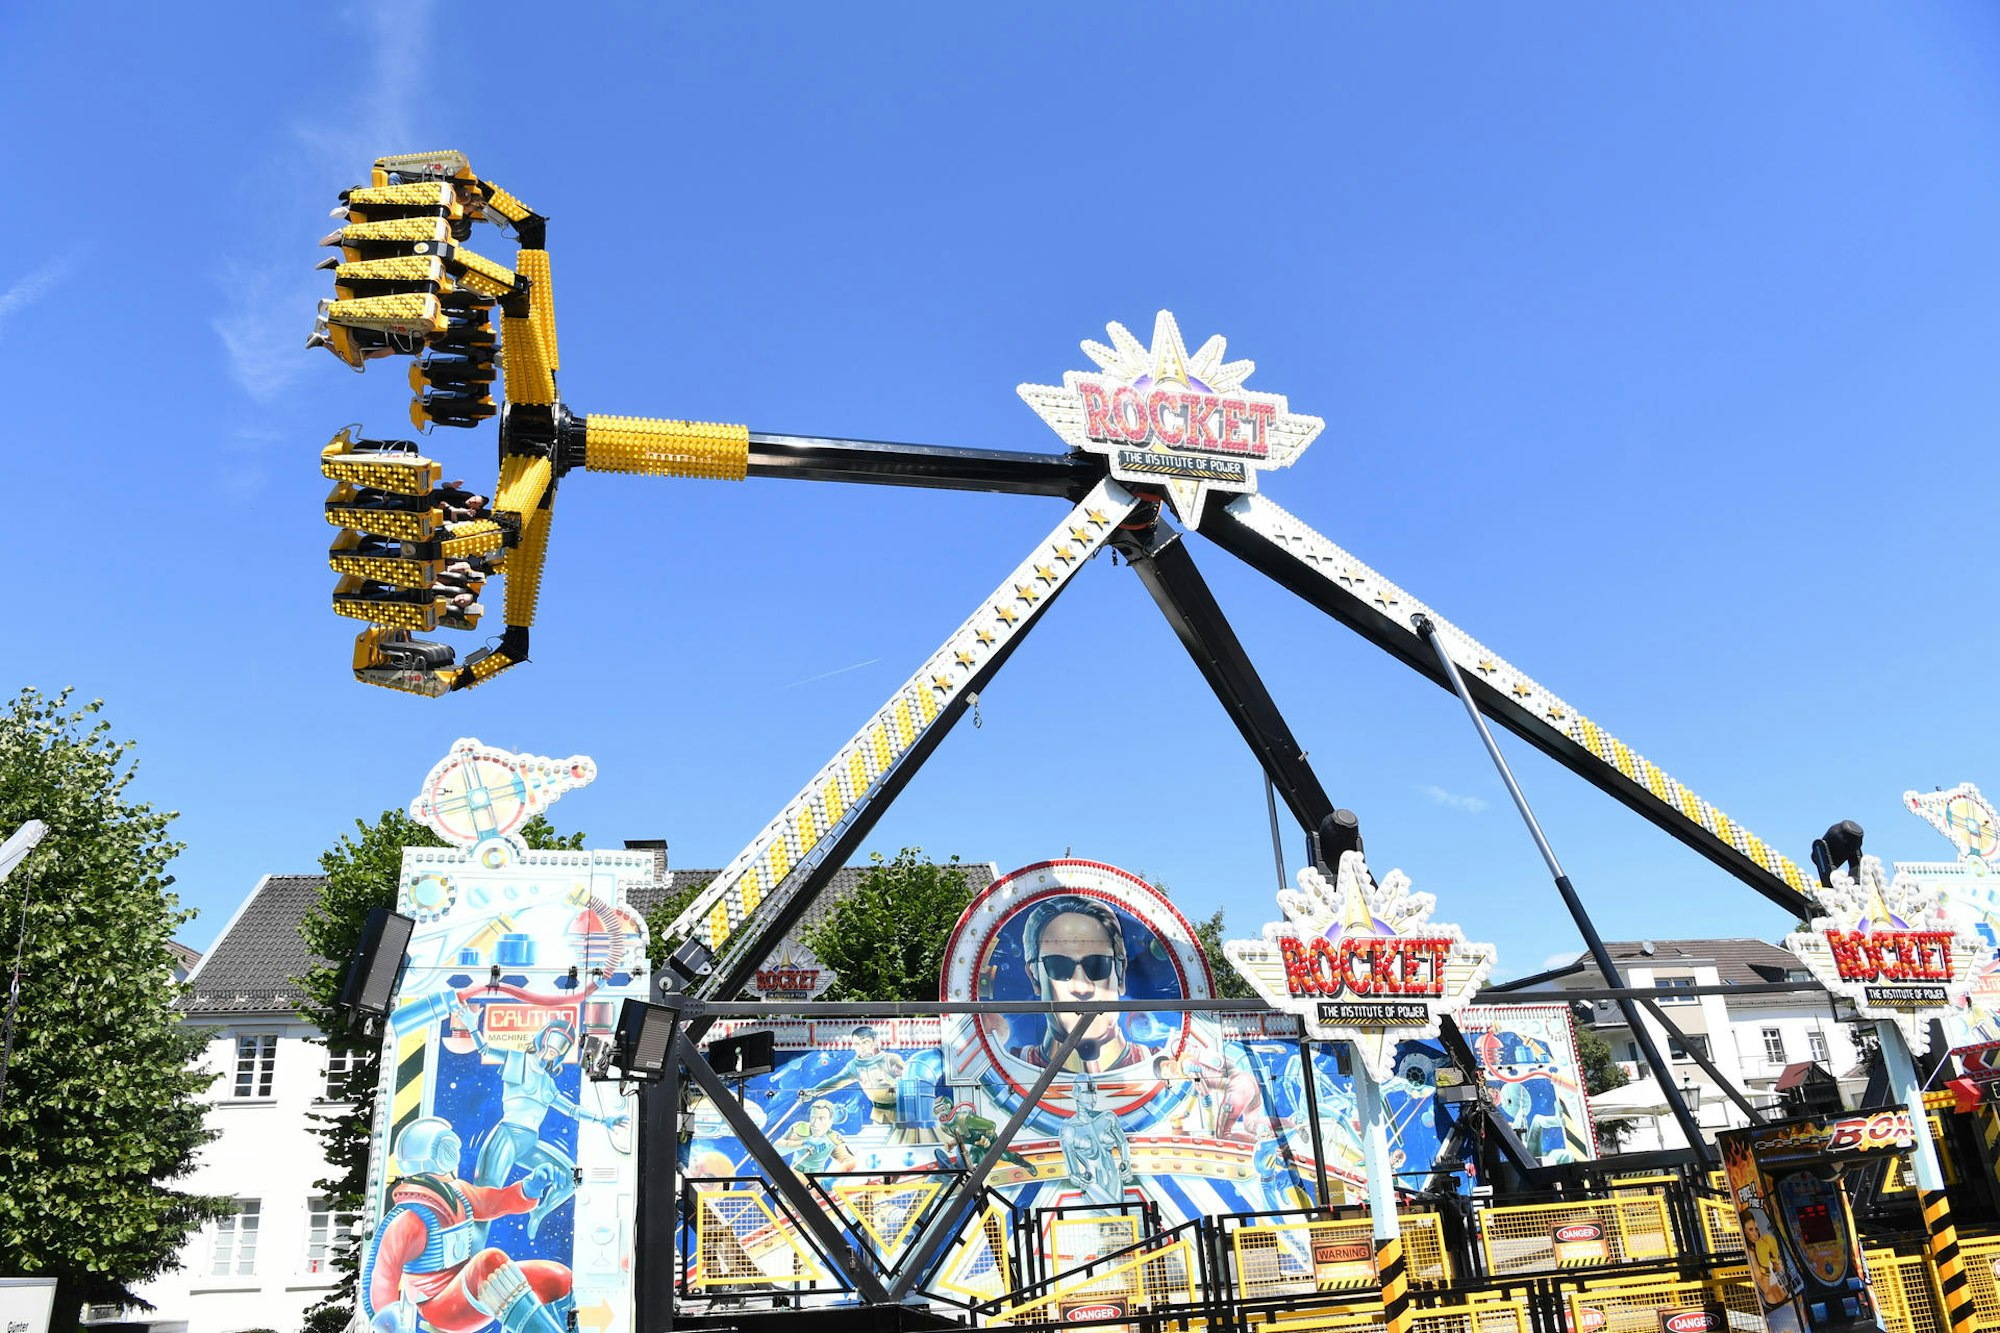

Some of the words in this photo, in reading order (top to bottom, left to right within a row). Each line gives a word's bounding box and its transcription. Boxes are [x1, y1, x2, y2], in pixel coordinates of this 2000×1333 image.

[1077, 382, 1276, 457] ROCKET
[1124, 451, 1142, 464] THE
[1145, 453, 1194, 470] INSTITUTE
[1196, 459, 1208, 470] OF
[1210, 461, 1242, 474] POWER
[1825, 929, 1955, 979] ROCKET
[1278, 936, 1454, 994] ROCKET
[755, 969, 820, 991] ROCKET
[1868, 988, 1882, 999] THE
[1914, 988, 1923, 999] OF
[1923, 988, 1946, 999] POWER
[1322, 1005, 1339, 1018] THE
[1340, 1005, 1384, 1018] INSTITUTE
[1384, 1006, 1396, 1017] OF
[1397, 1006, 1425, 1018] POWER
[488, 1034, 529, 1042] MACHINE
[1562, 1228, 1595, 1239] DANGER
[1318, 1247, 1367, 1260] WARNING
[1074, 1308, 1115, 1320] DANGER
[1673, 1315, 1715, 1329] DANGER
